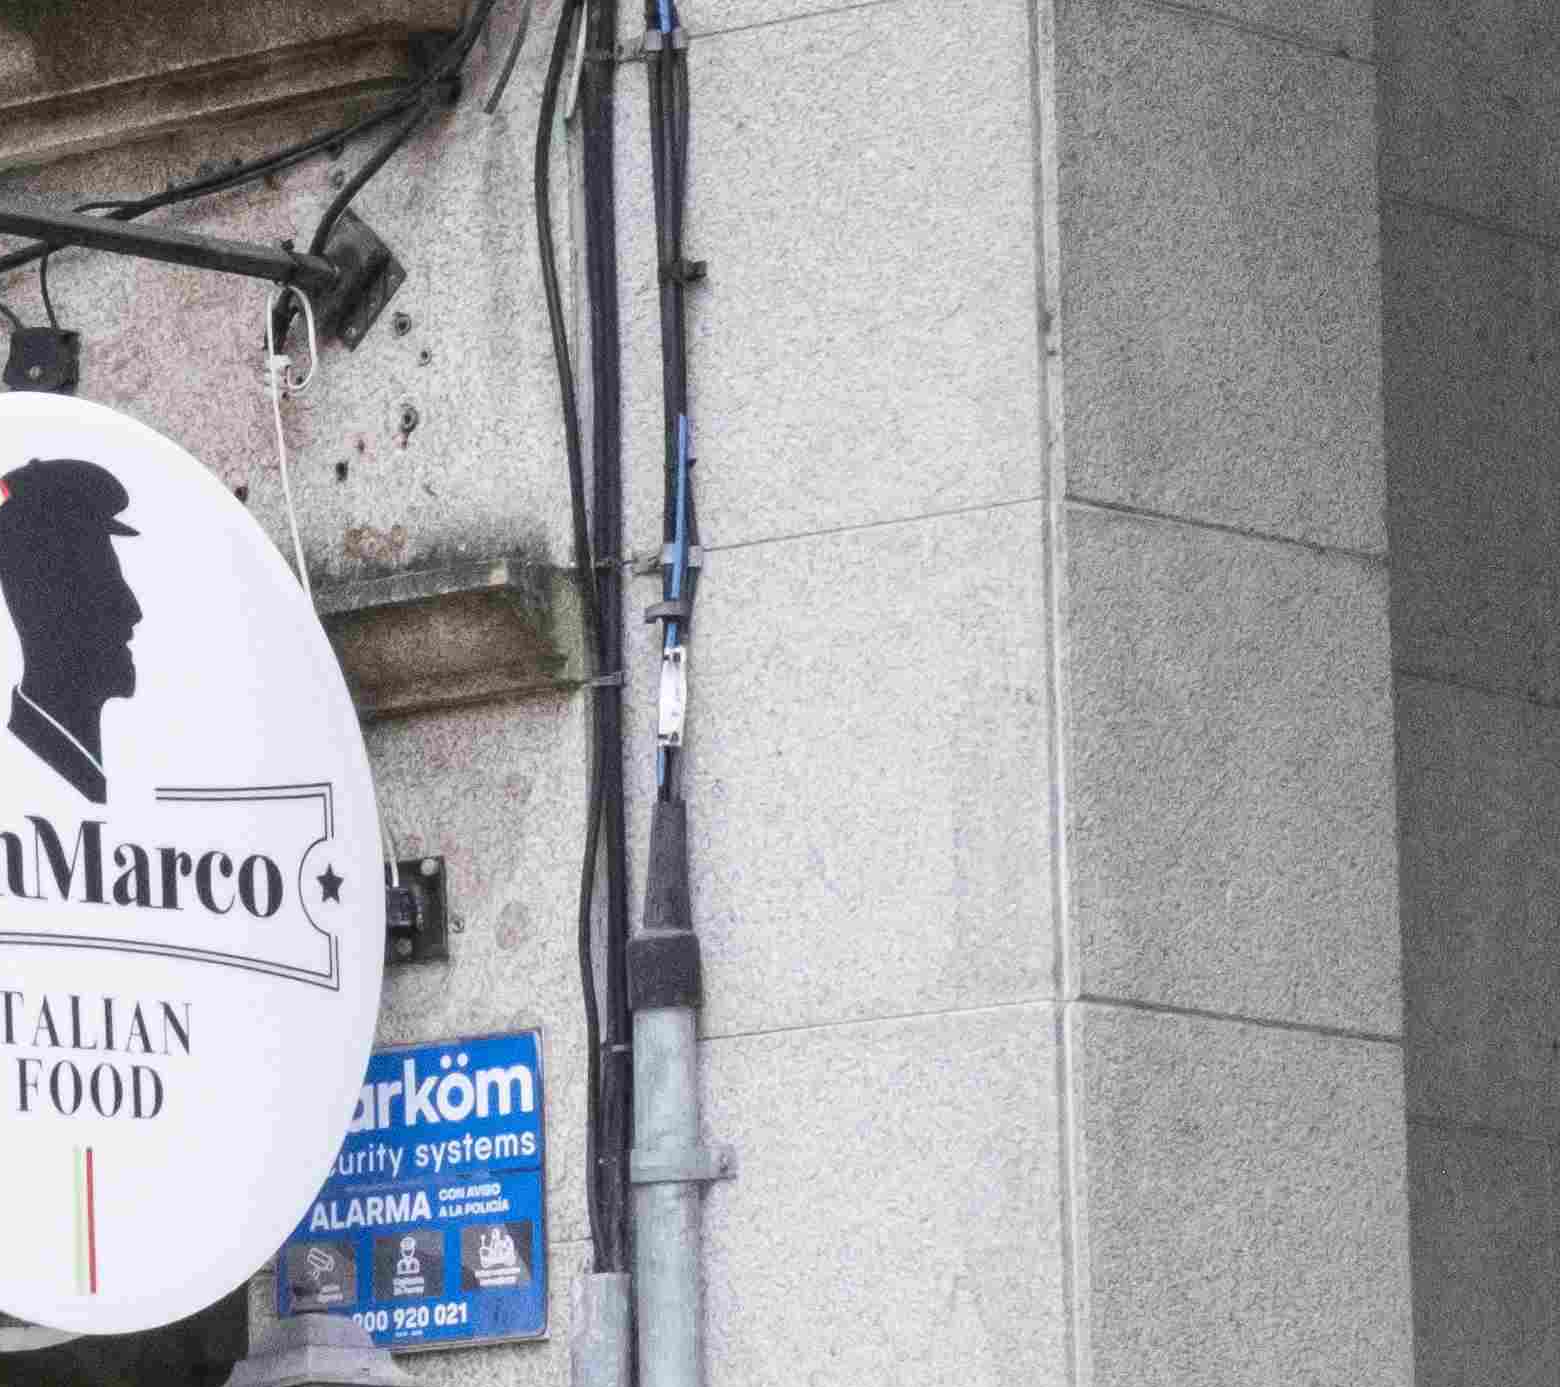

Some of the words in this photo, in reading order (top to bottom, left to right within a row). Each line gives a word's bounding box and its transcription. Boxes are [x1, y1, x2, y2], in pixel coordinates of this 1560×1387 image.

[16, 1056, 164, 1119] FOOD
[329, 1143, 403, 1177] urity
[415, 1131, 536, 1172] systems
[310, 1191, 432, 1232] ALARMA
[393, 1305, 429, 1329] 920
[434, 1301, 468, 1326] 021
